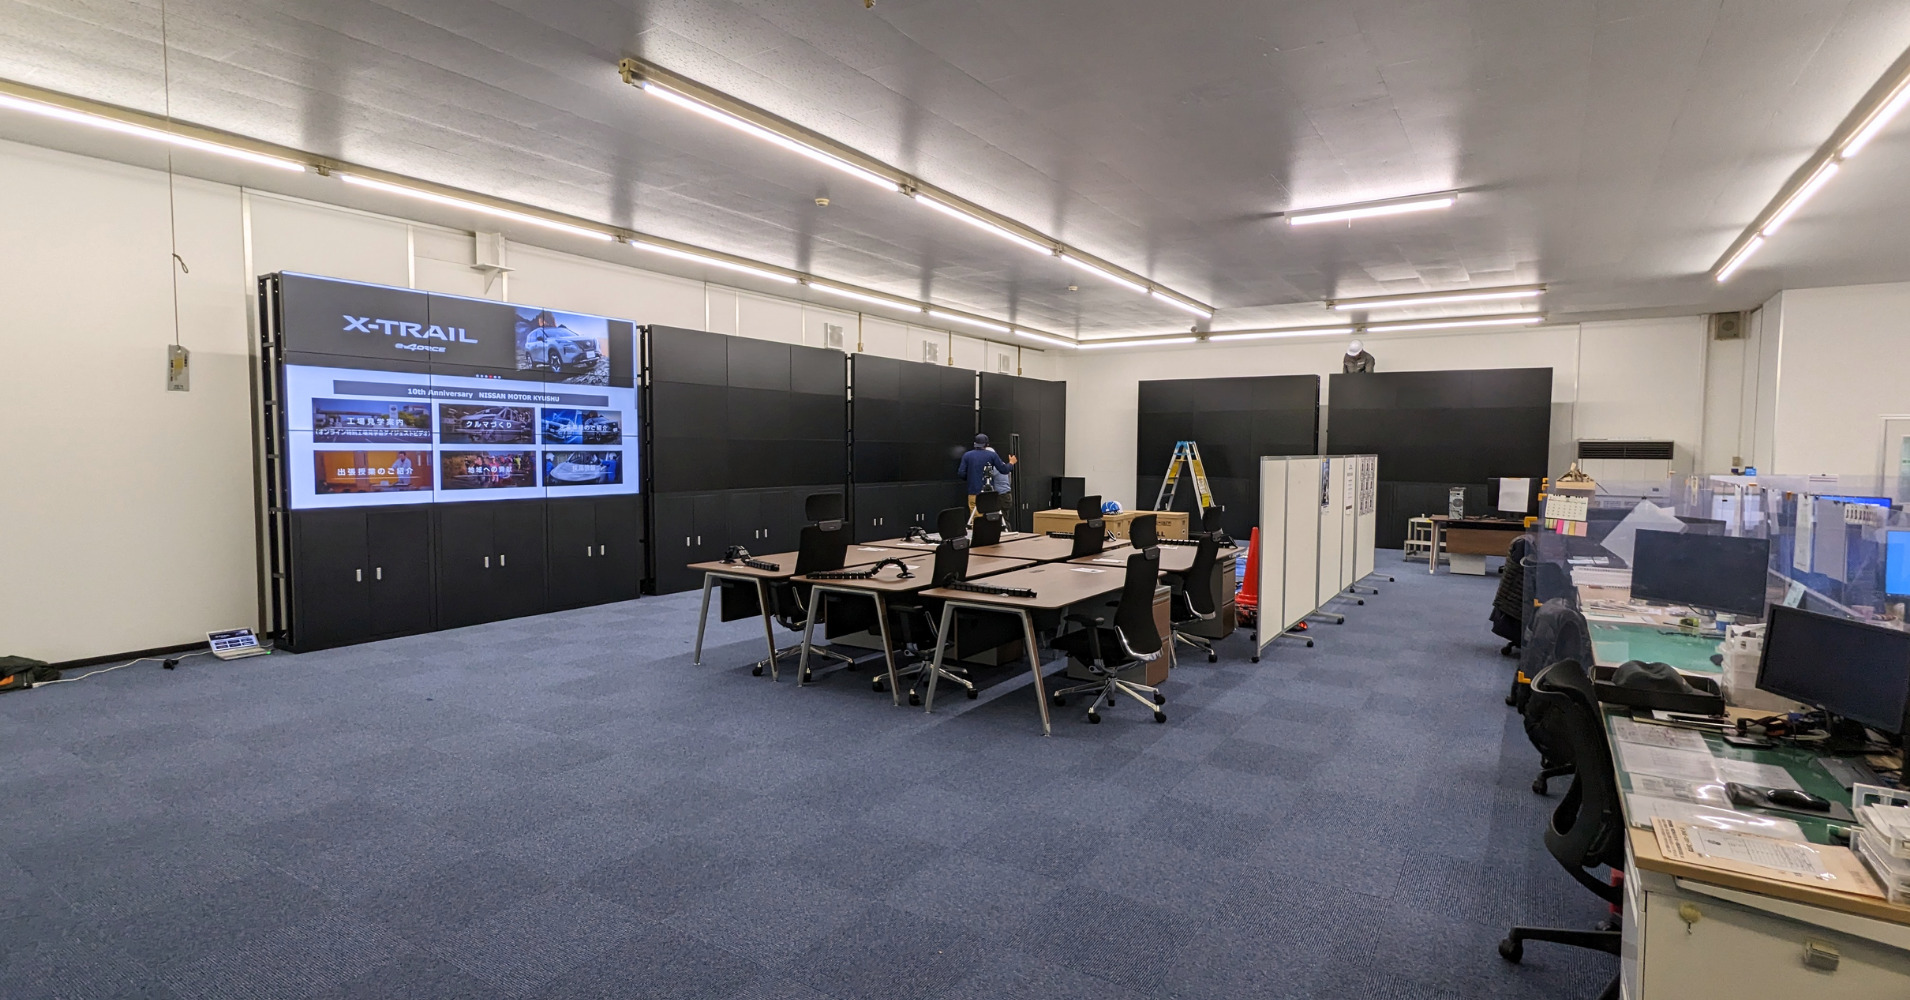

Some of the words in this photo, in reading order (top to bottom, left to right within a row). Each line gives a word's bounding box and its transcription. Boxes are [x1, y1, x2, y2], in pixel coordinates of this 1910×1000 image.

[343, 314, 479, 344] X-TRAIL
[407, 388, 426, 396] 10th
[427, 389, 474, 399] Anniversary
[478, 391, 507, 400] NISSAN
[507, 393, 532, 401] MOTOR
[533, 394, 560, 402] KYUSHU
[346, 417, 404, 426] 工場見学案内
[466, 420, 512, 428] クルマづくり
[337, 467, 414, 477] 出張授業のご紹介
